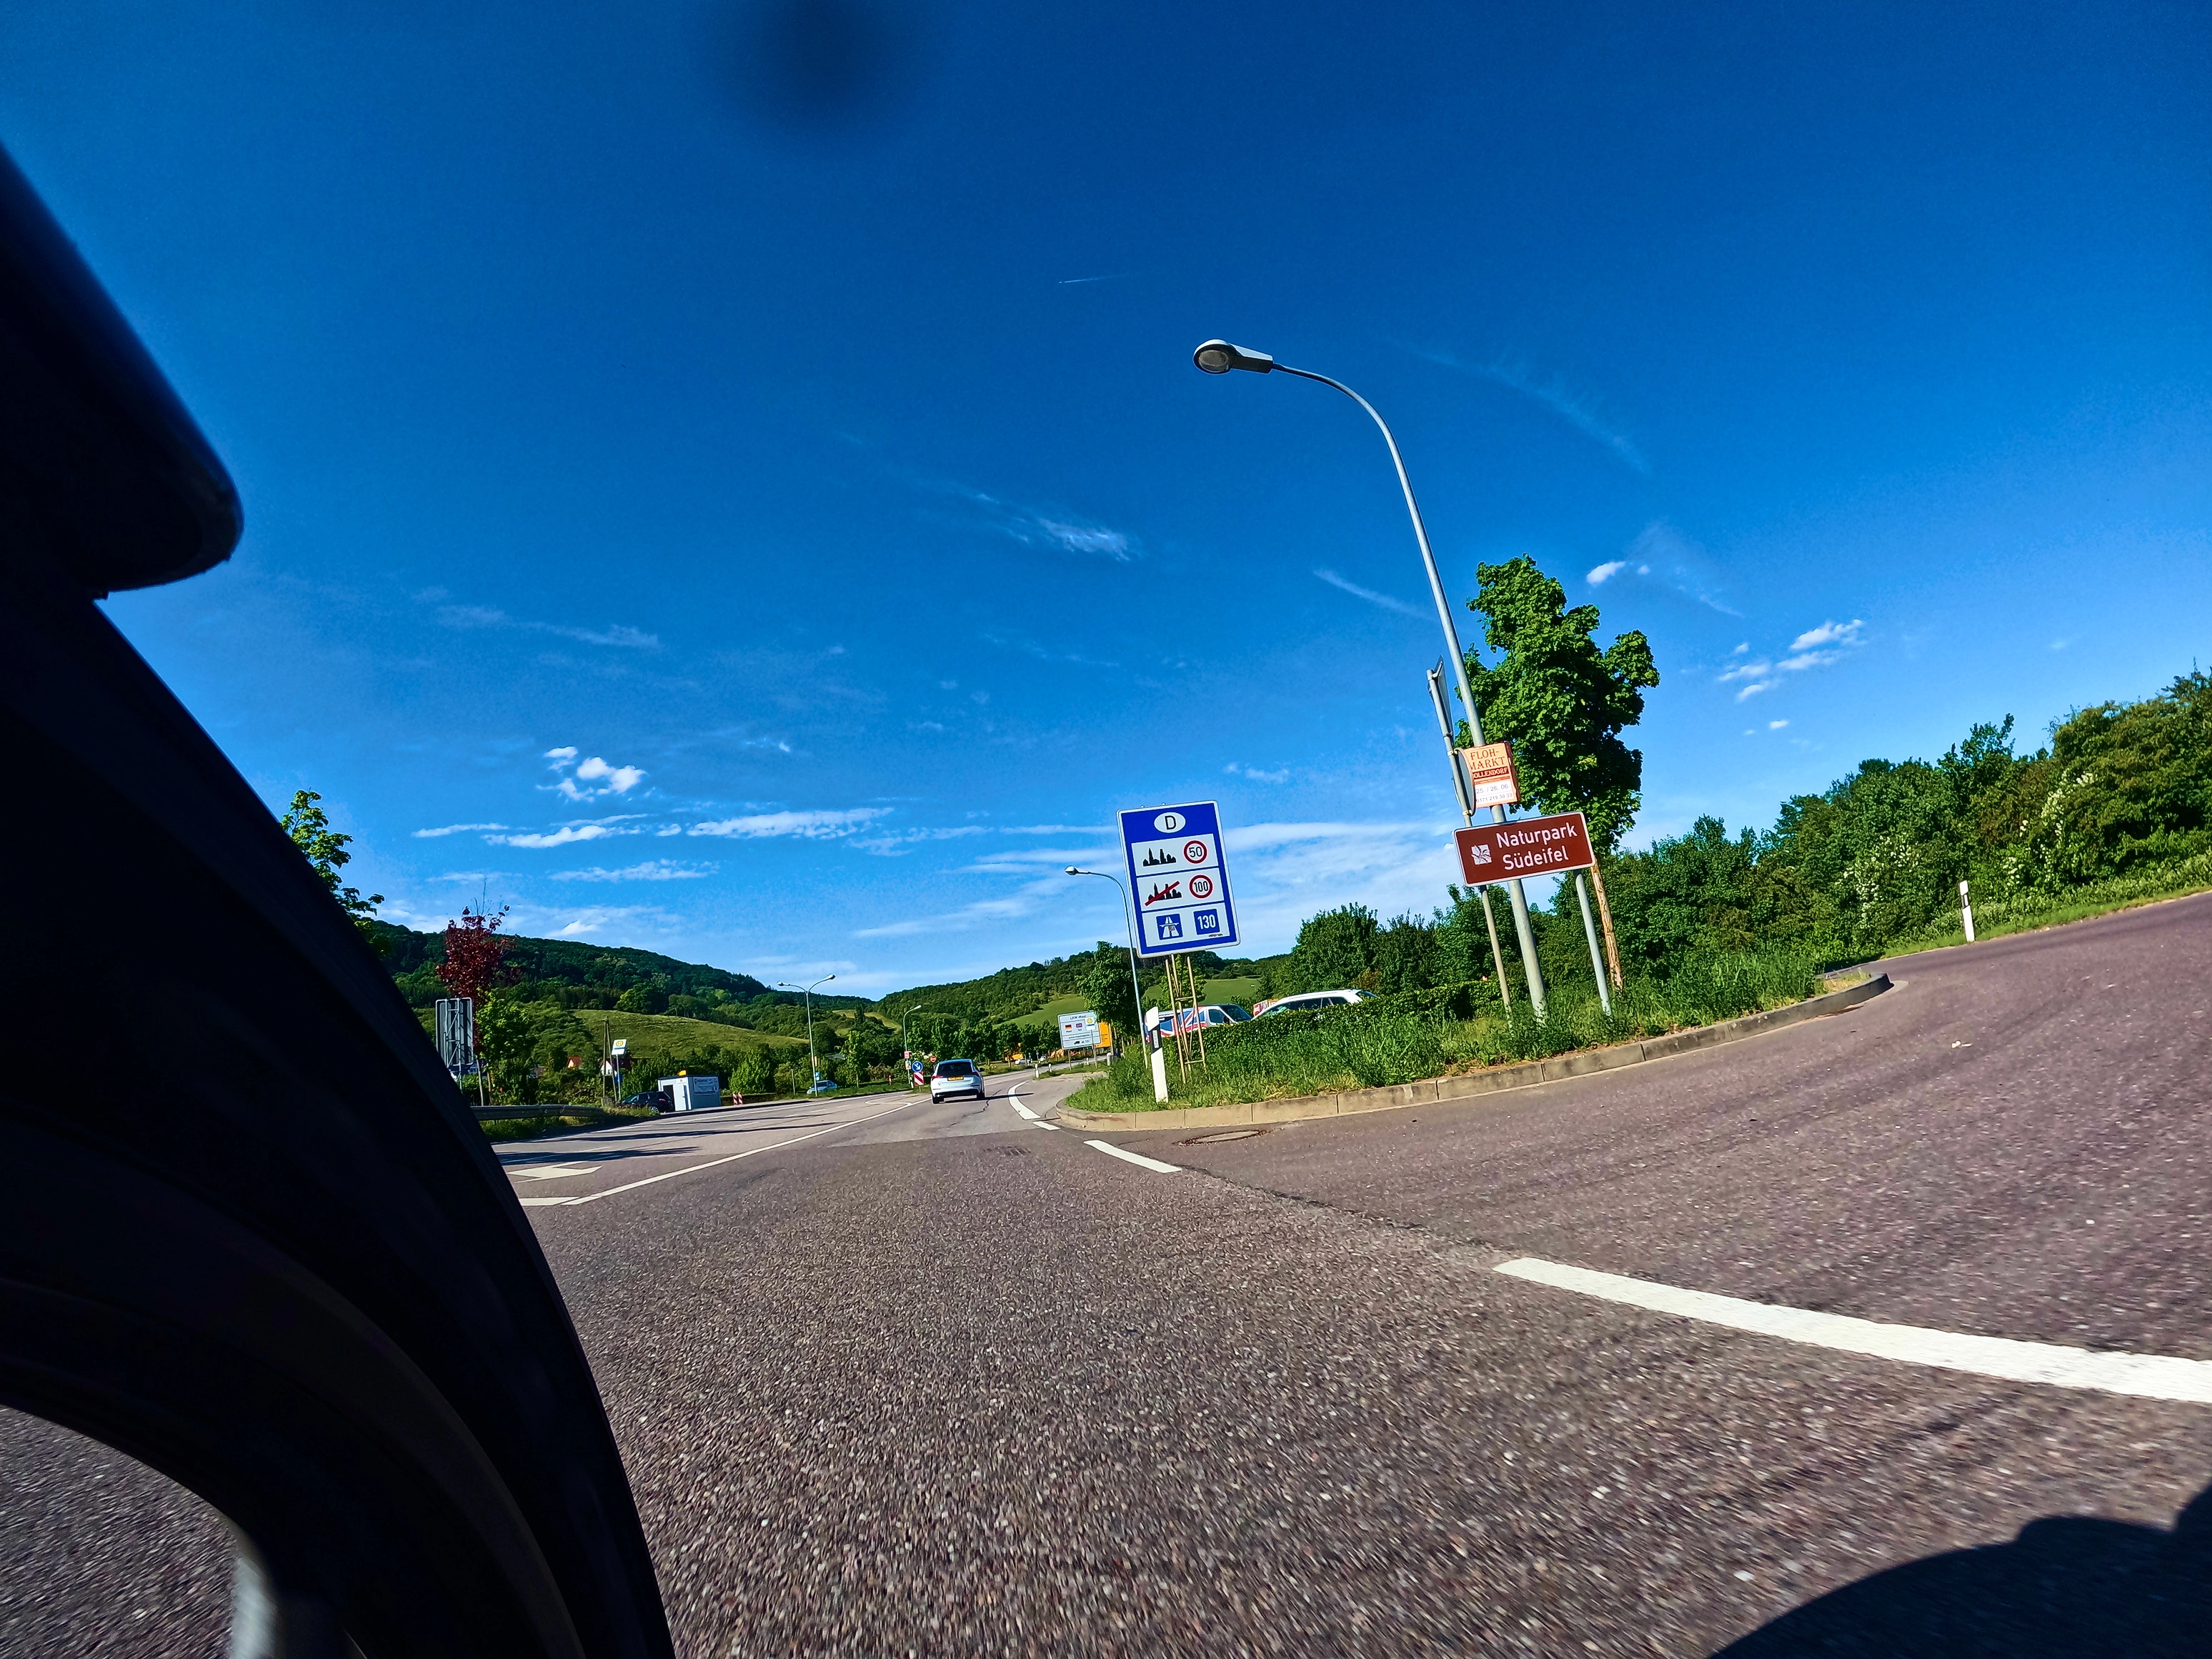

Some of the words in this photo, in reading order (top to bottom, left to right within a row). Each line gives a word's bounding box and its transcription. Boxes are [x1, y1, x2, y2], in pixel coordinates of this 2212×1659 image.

[1470, 748, 1500, 761] FLOH-
[1470, 756, 1505, 770] MARKT
[1473, 767, 1508, 779] OLLENDORF
[1165, 815, 1177, 830] D
[1496, 822, 1578, 849] Naturpark
[1188, 846, 1202, 858] 50
[1503, 845, 1569, 870] Südeifel
[1193, 880, 1209, 892] 100
[1197, 914, 1216, 930] 130
